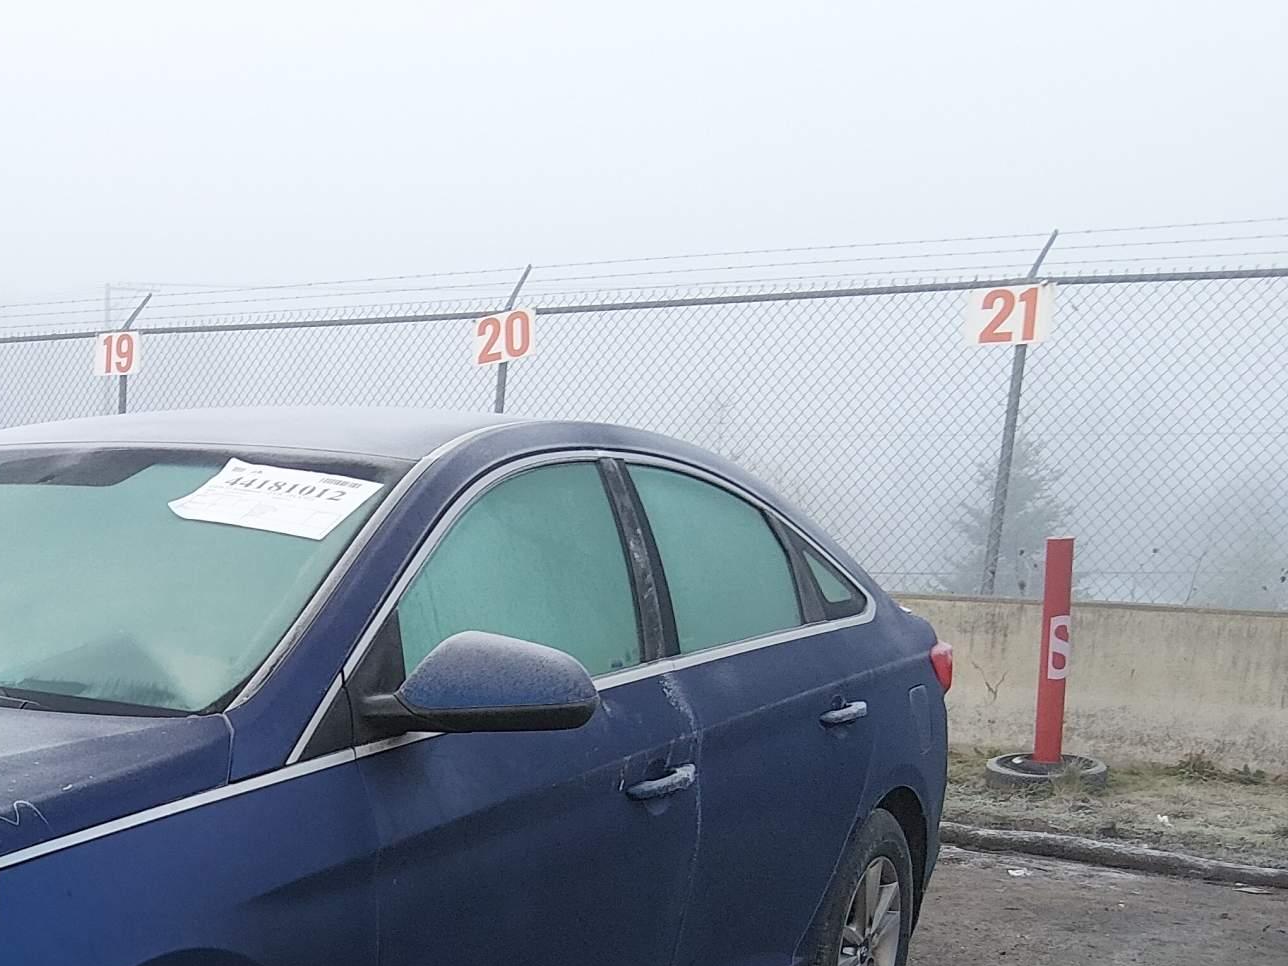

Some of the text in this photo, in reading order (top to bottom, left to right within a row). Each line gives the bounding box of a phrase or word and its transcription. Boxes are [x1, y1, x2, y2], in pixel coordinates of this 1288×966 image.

[477, 310, 530, 365] 20
[978, 286, 1039, 344] 21
[103, 333, 134, 374] 19
[224, 475, 348, 502] 44181012
